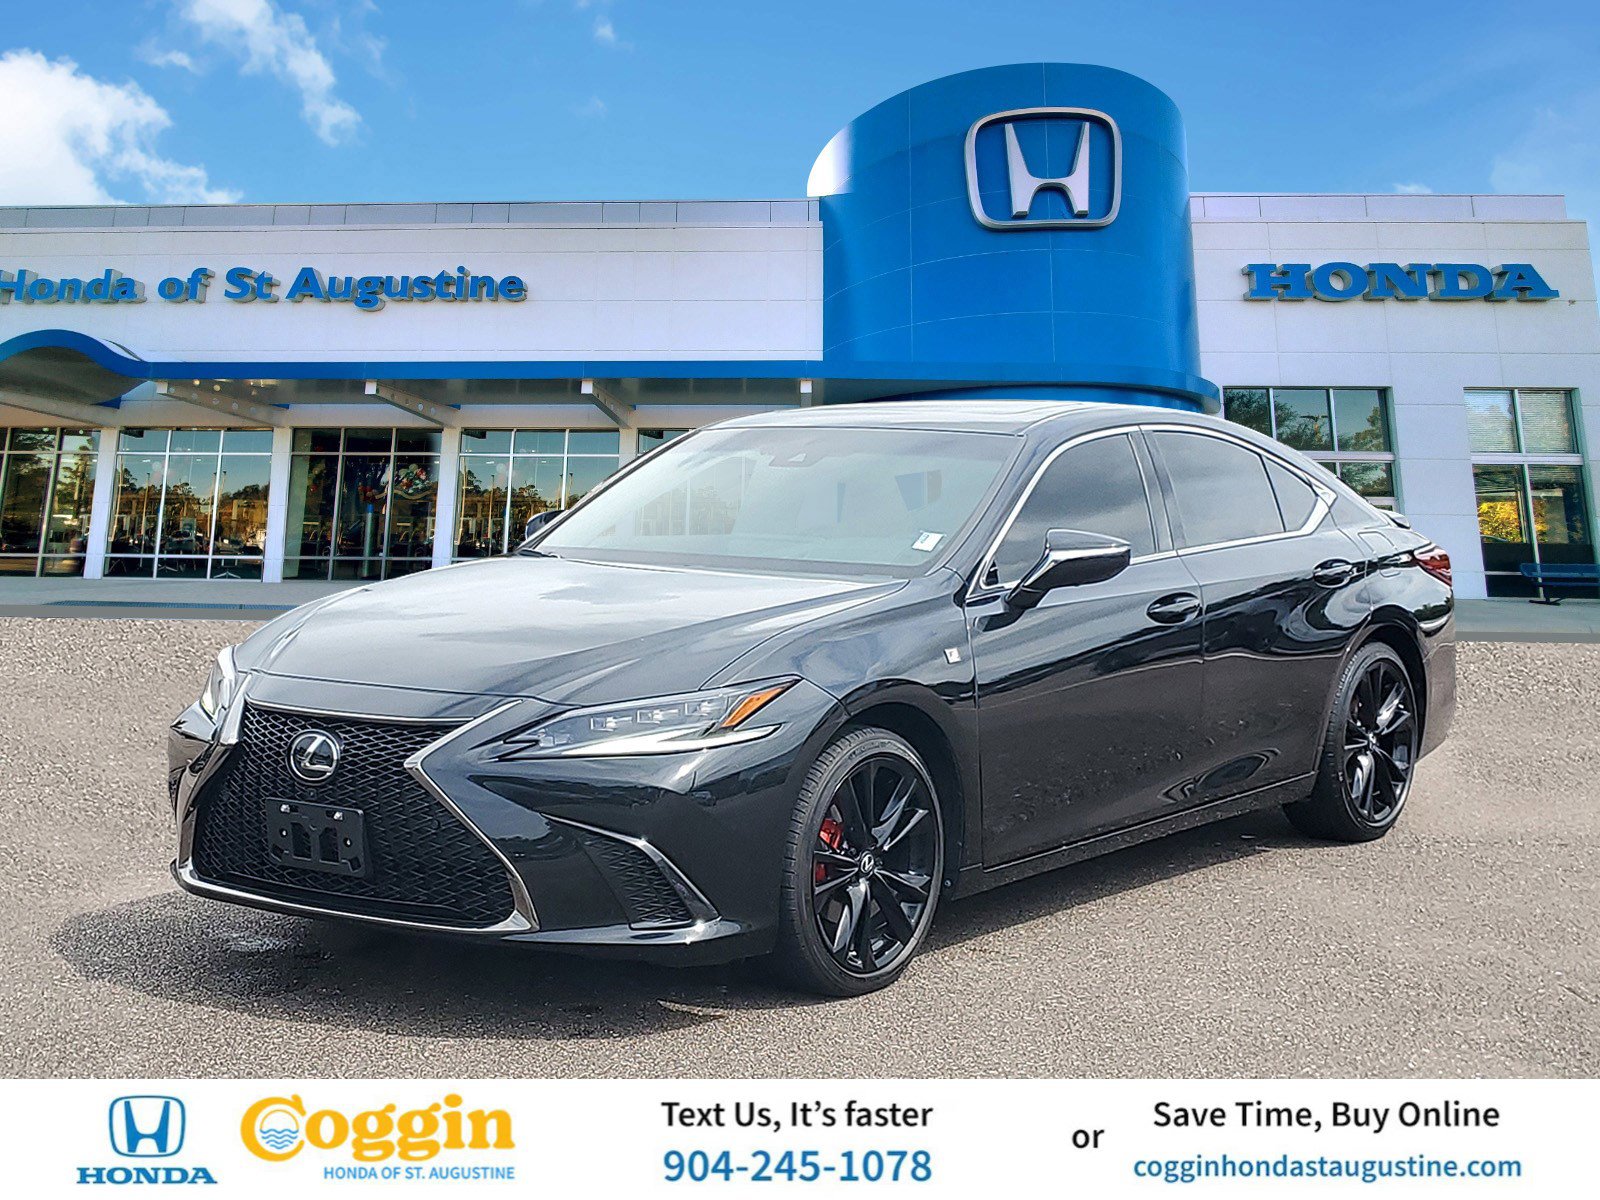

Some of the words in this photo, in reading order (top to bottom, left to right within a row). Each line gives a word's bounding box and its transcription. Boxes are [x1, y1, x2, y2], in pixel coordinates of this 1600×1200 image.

[0, 268, 146, 304] Honda
[158, 267, 215, 303] of
[224, 267, 281, 303] St
[286, 265, 528, 312] Augustine
[1241, 261, 1559, 302] HONDA
